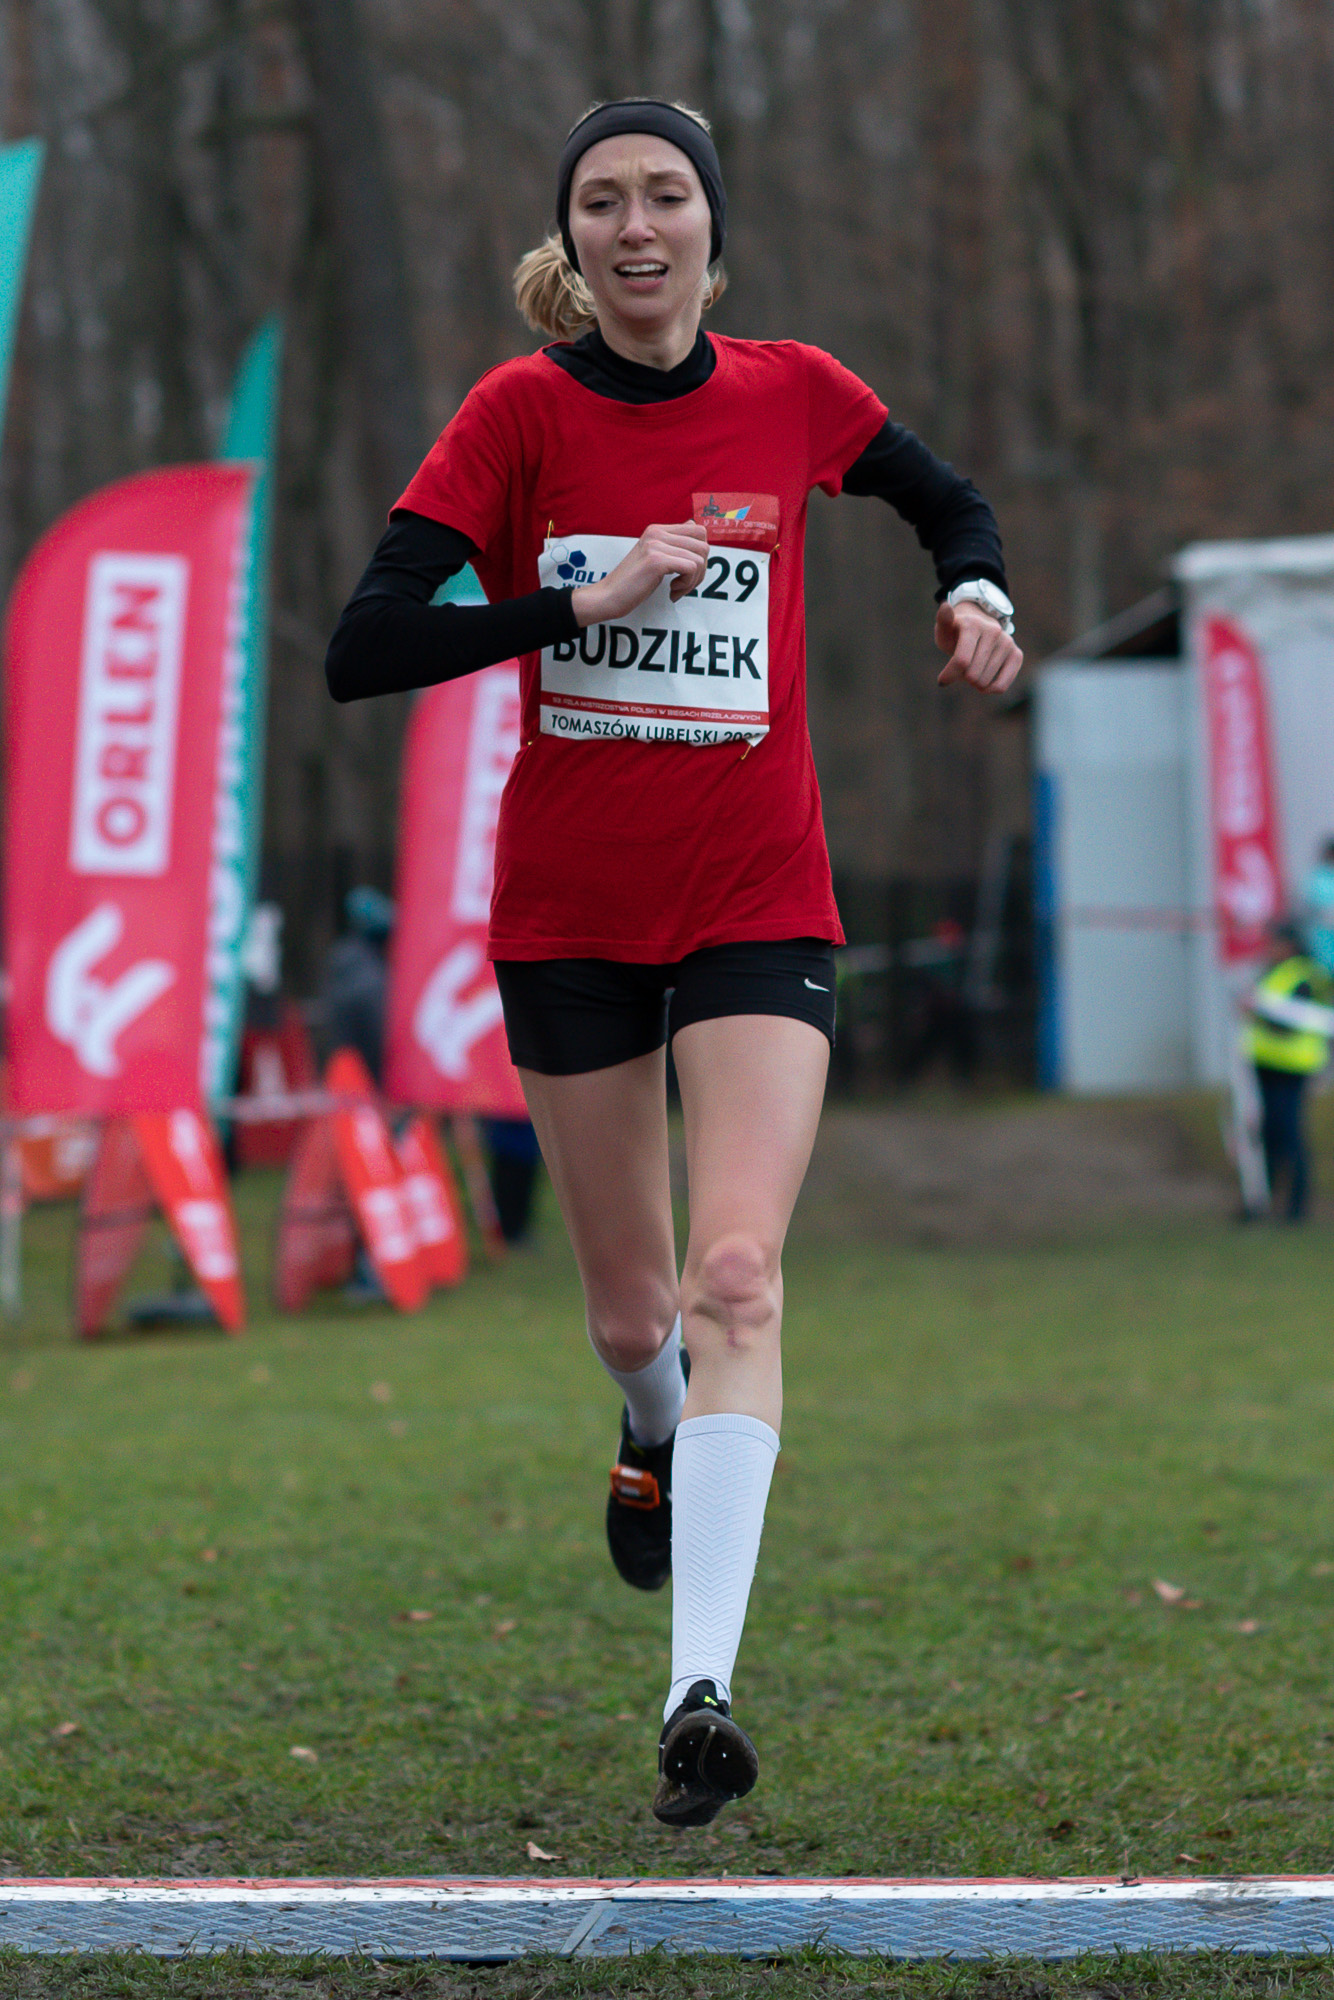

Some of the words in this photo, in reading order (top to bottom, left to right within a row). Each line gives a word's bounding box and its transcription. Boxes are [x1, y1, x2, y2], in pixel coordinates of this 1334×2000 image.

[685, 555, 759, 602] 29
[553, 624, 762, 680] BUDZIŁEK
[95, 582, 161, 847] ORLEN
[552, 714, 640, 738] TOMASZÓW
[646, 726, 718, 743] LUBELSKI
[724, 731, 761, 742] 20
[580, 701, 629, 712] MISTRZOSTWA
[631, 706, 657, 714] POLSKI
[667, 709, 699, 717] BIEGACH
